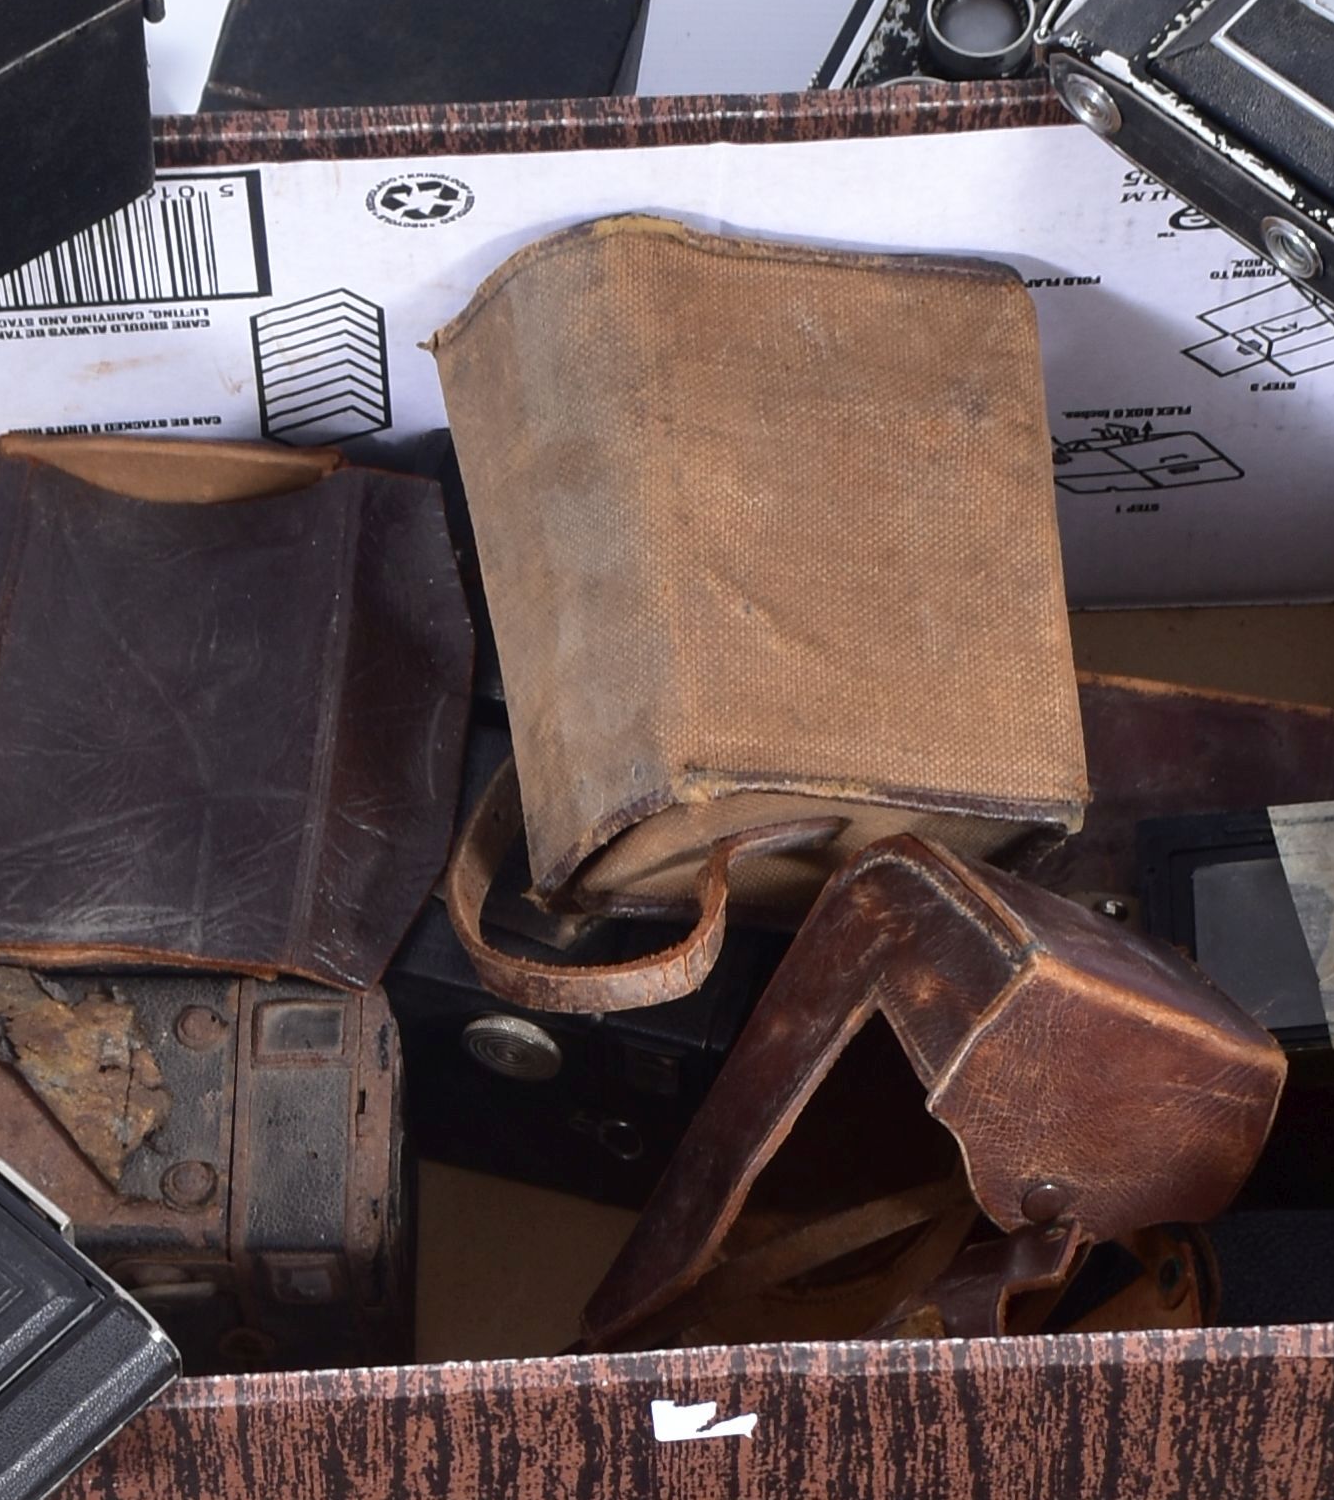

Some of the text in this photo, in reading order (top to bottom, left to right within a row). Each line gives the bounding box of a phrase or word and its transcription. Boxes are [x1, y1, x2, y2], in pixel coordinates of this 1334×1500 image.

[219, 185, 234, 198] 5
[1210, 270, 1228, 280] TO
[1063, 275, 1101, 286] FOLD
[71, 311, 144, 323] CARRYING
[148, 307, 209, 318] LIFTING,
[38, 315, 67, 325] AND
[172, 319, 210, 329] CARE
[48, 325, 107, 336] ALWAYS
[110, 322, 167, 333] SHOULD
[25, 328, 44, 338] BE
[1262, 382, 1295, 392] STEP
[1127, 407, 1154, 418] BOX
[1157, 405, 1191, 415] FLEX
[104, 418, 167, 431] STACKED
[170, 417, 189, 427] BE
[192, 415, 221, 425] CAN
[45, 424, 88, 435] UNITS
[1126, 503, 1159, 512] STEP
